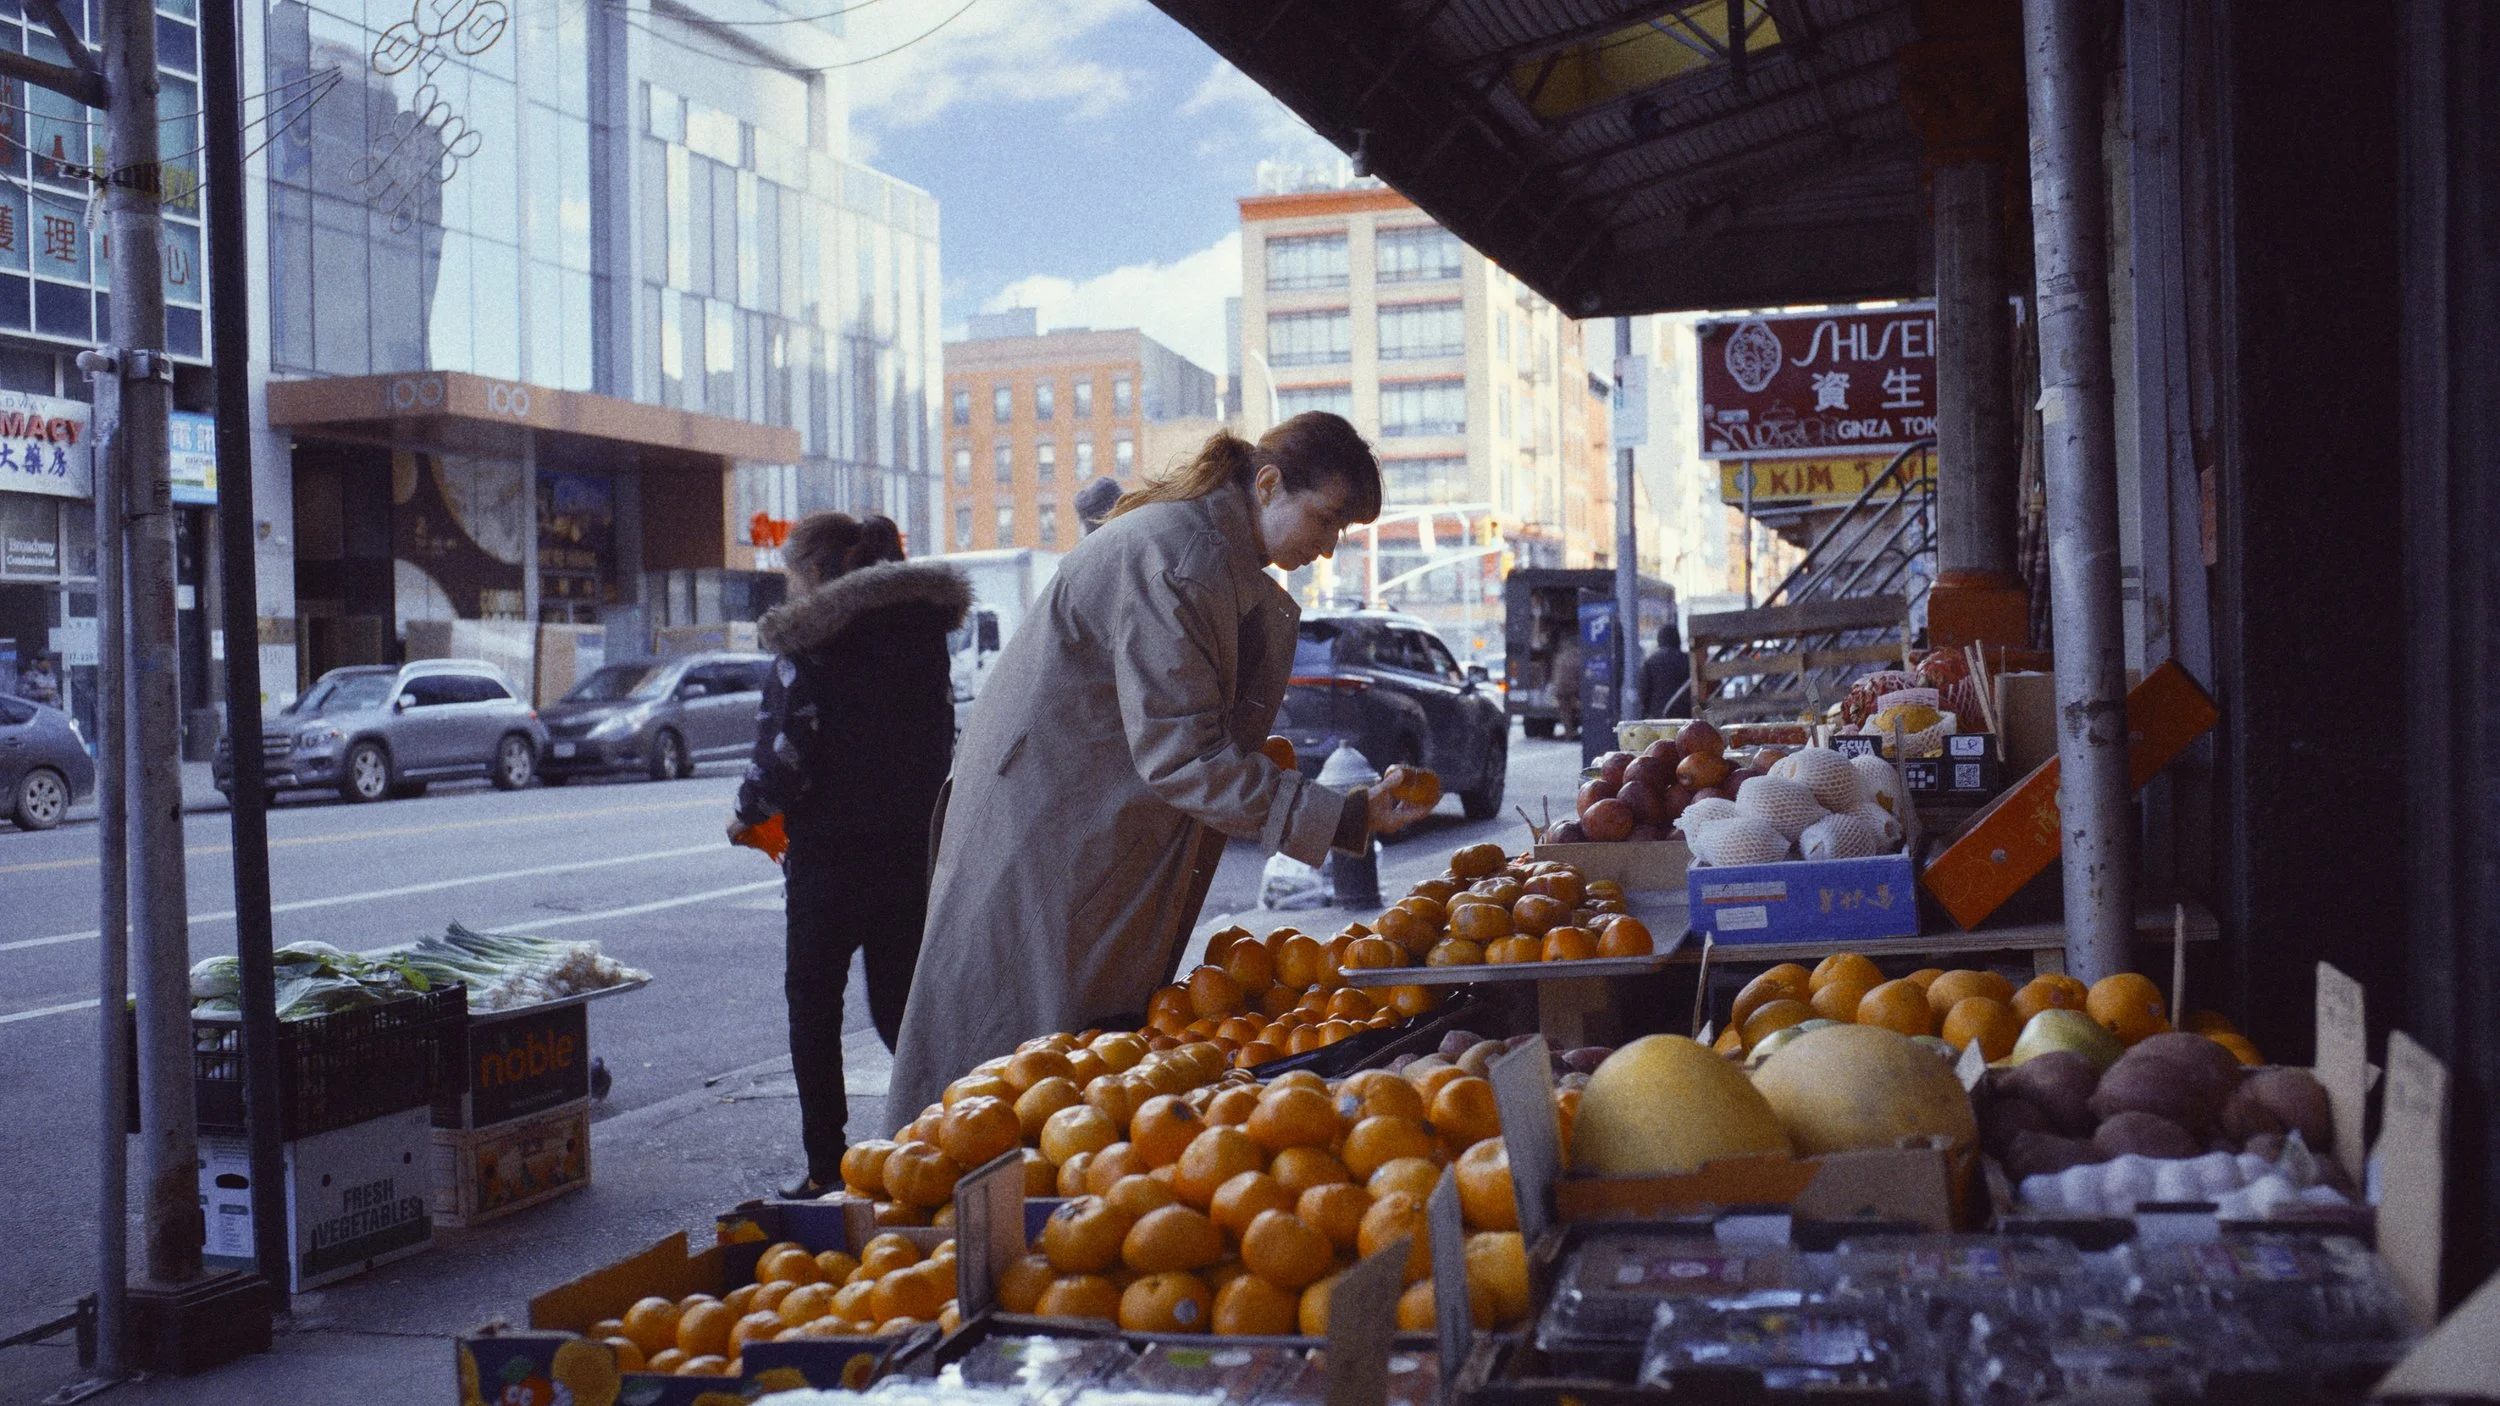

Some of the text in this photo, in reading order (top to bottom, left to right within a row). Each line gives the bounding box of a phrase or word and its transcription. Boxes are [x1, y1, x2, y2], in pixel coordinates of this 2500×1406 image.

[385, 377, 443, 410] 100
[486, 382, 529, 418] 100
[1811, 366, 1925, 412] 資生
[1838, 418, 1893, 440] GINZA
[1770, 464, 1835, 494] KIM
[481, 1029, 575, 1089] noble
[343, 1177, 395, 1214] FRESH
[317, 1195, 422, 1246] VEGETABLES
